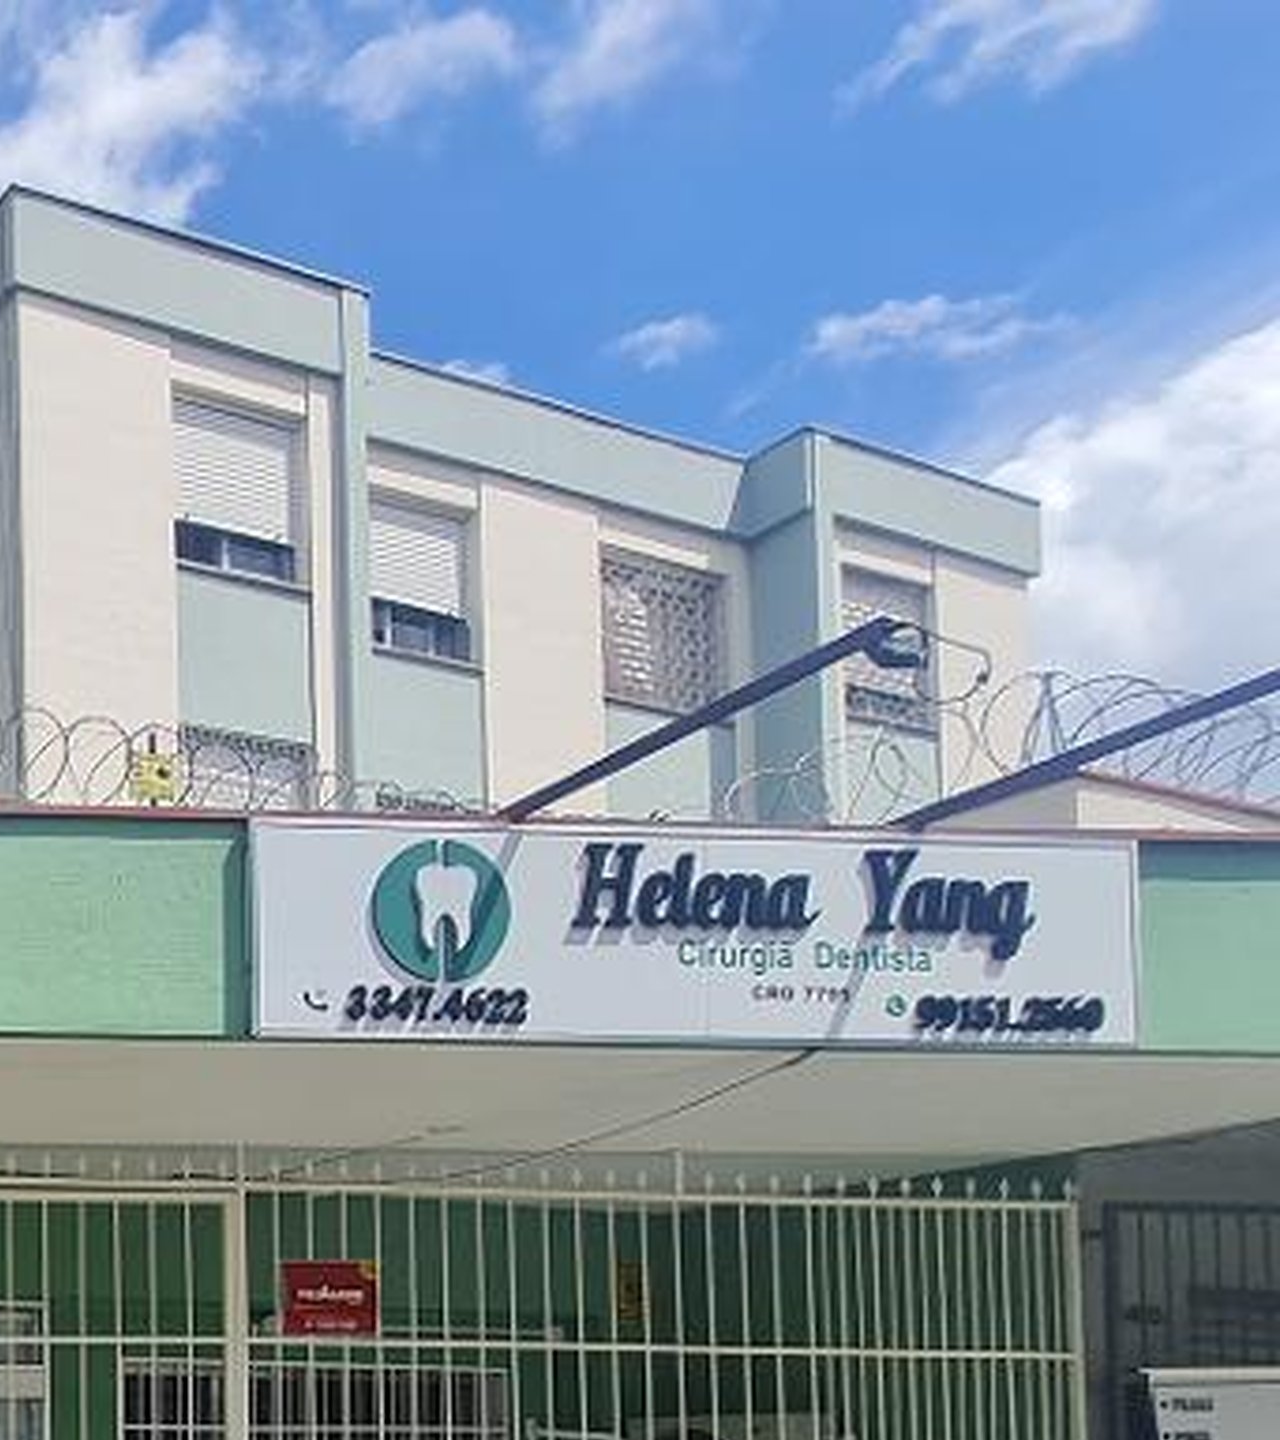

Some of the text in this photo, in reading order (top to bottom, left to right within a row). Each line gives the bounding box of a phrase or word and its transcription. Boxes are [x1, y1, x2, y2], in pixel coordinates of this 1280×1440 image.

[570, 842, 1037, 961] Helena Yang
[814, 940, 934, 973] Dentista
